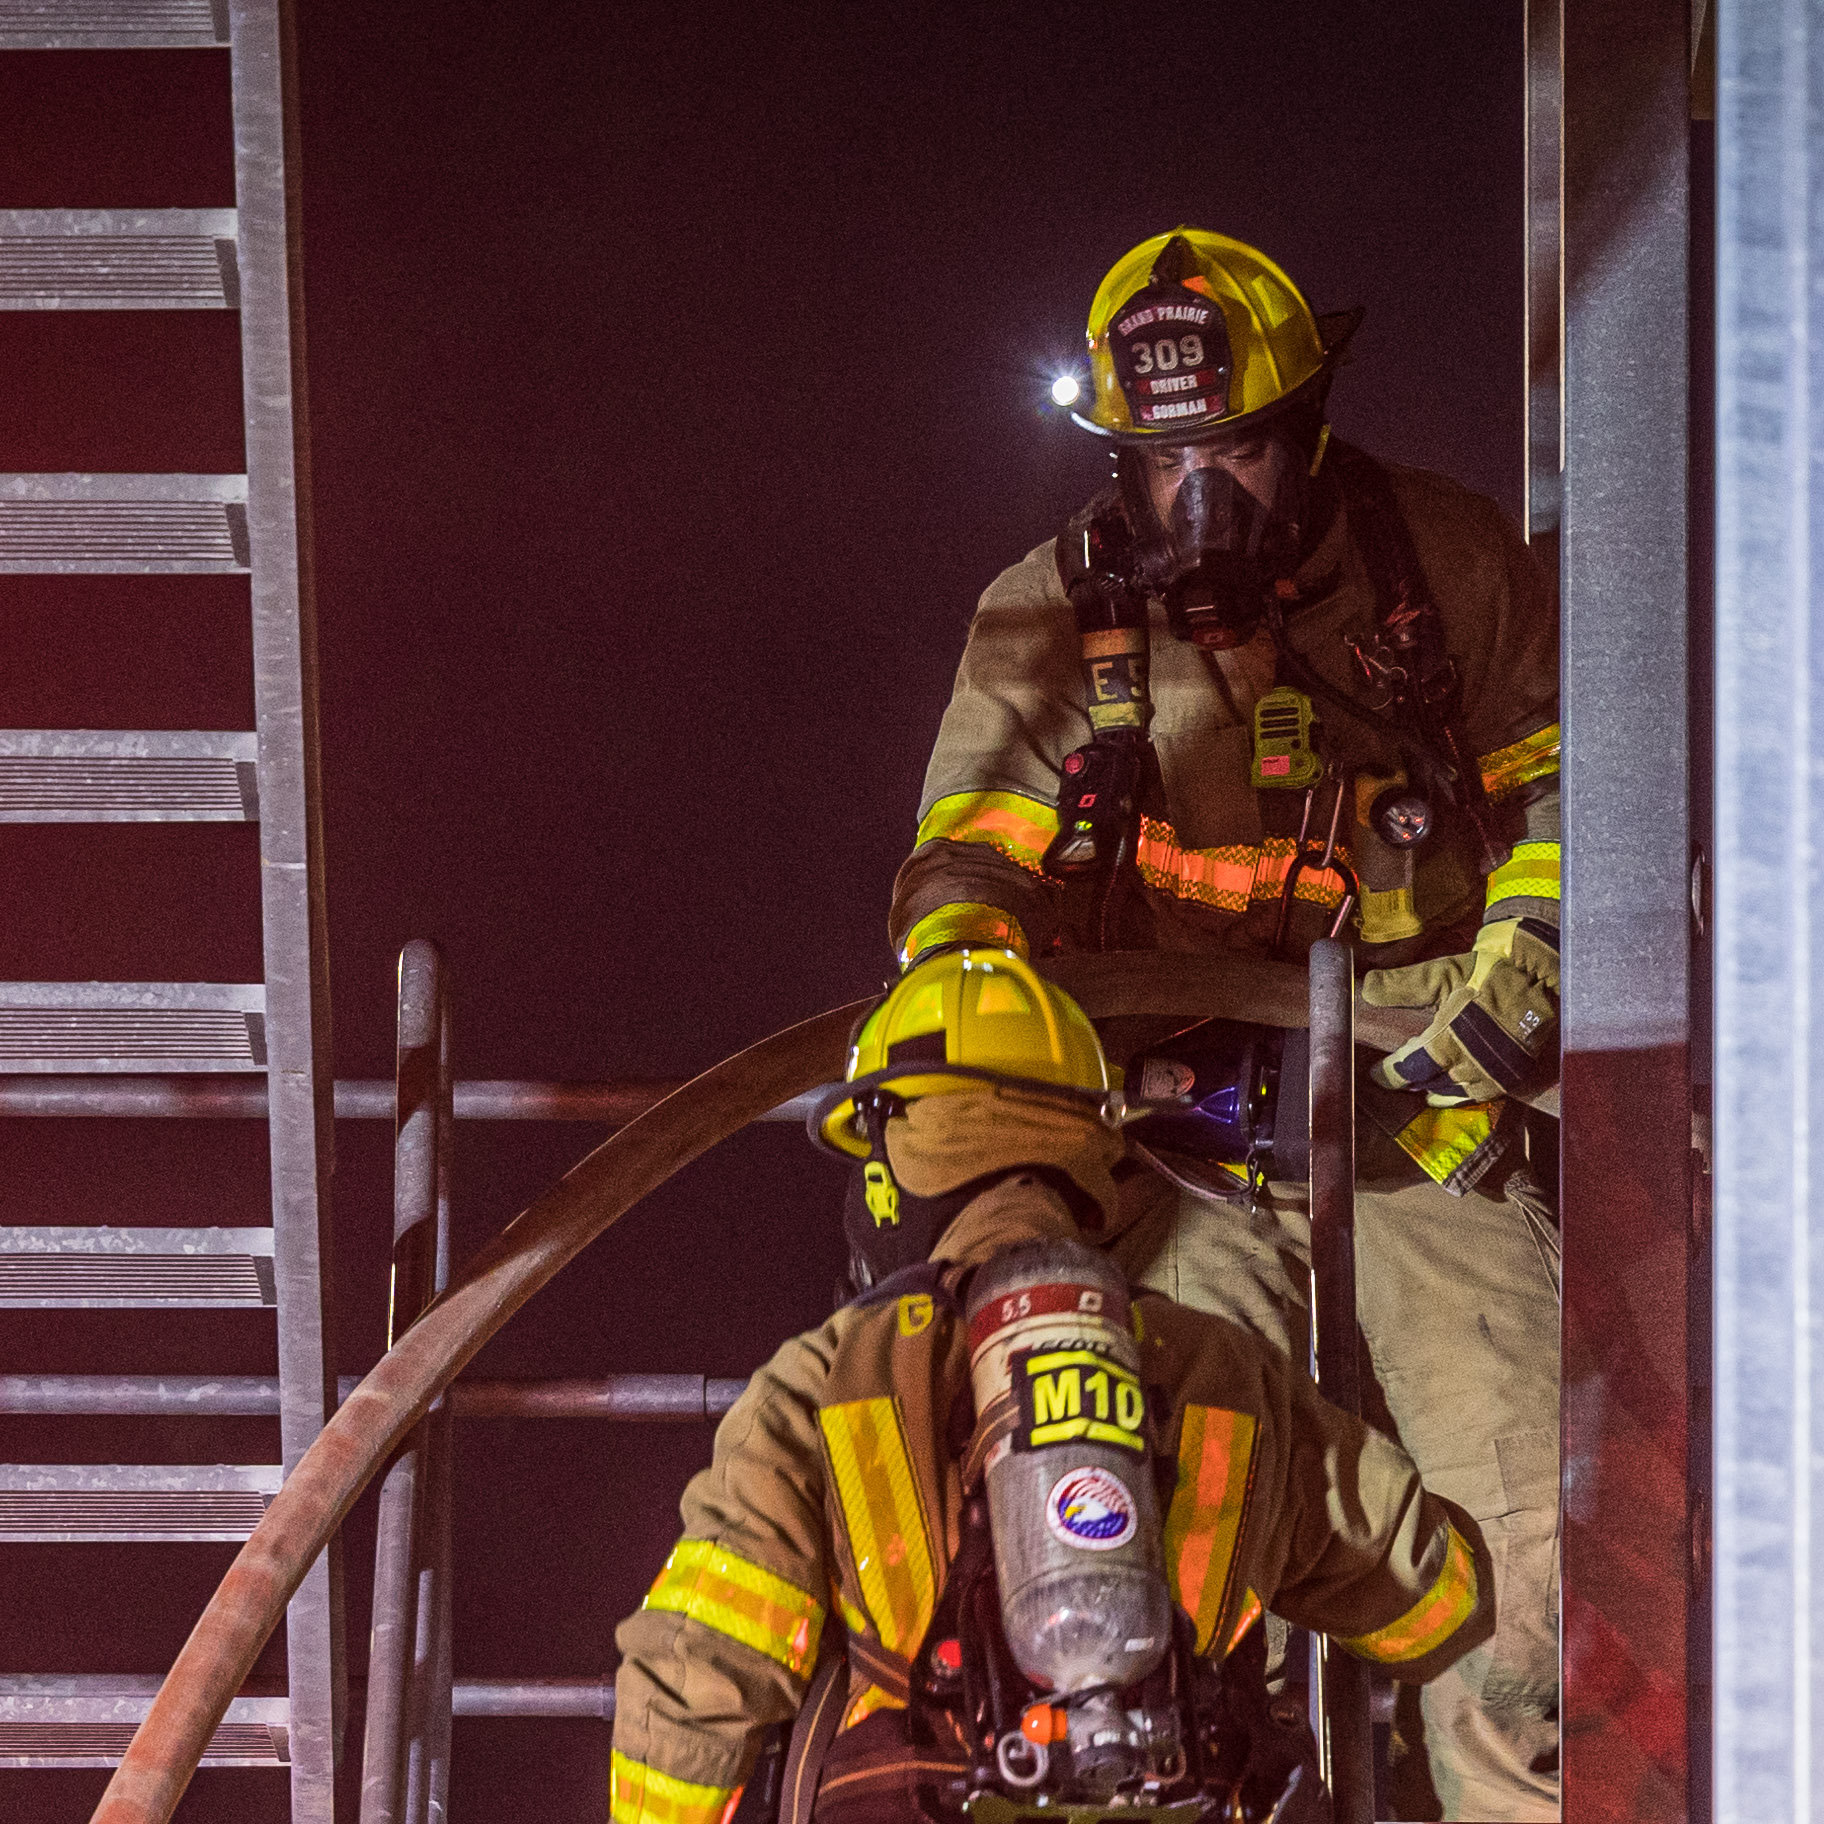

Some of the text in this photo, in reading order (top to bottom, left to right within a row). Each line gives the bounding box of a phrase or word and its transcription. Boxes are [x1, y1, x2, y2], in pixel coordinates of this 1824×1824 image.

[1157, 305, 1210, 325] PRAIRIE
[1131, 334, 1205, 375] 309
[1150, 374, 1198, 395] DRIVER
[1033, 1368, 1145, 1431] M10
